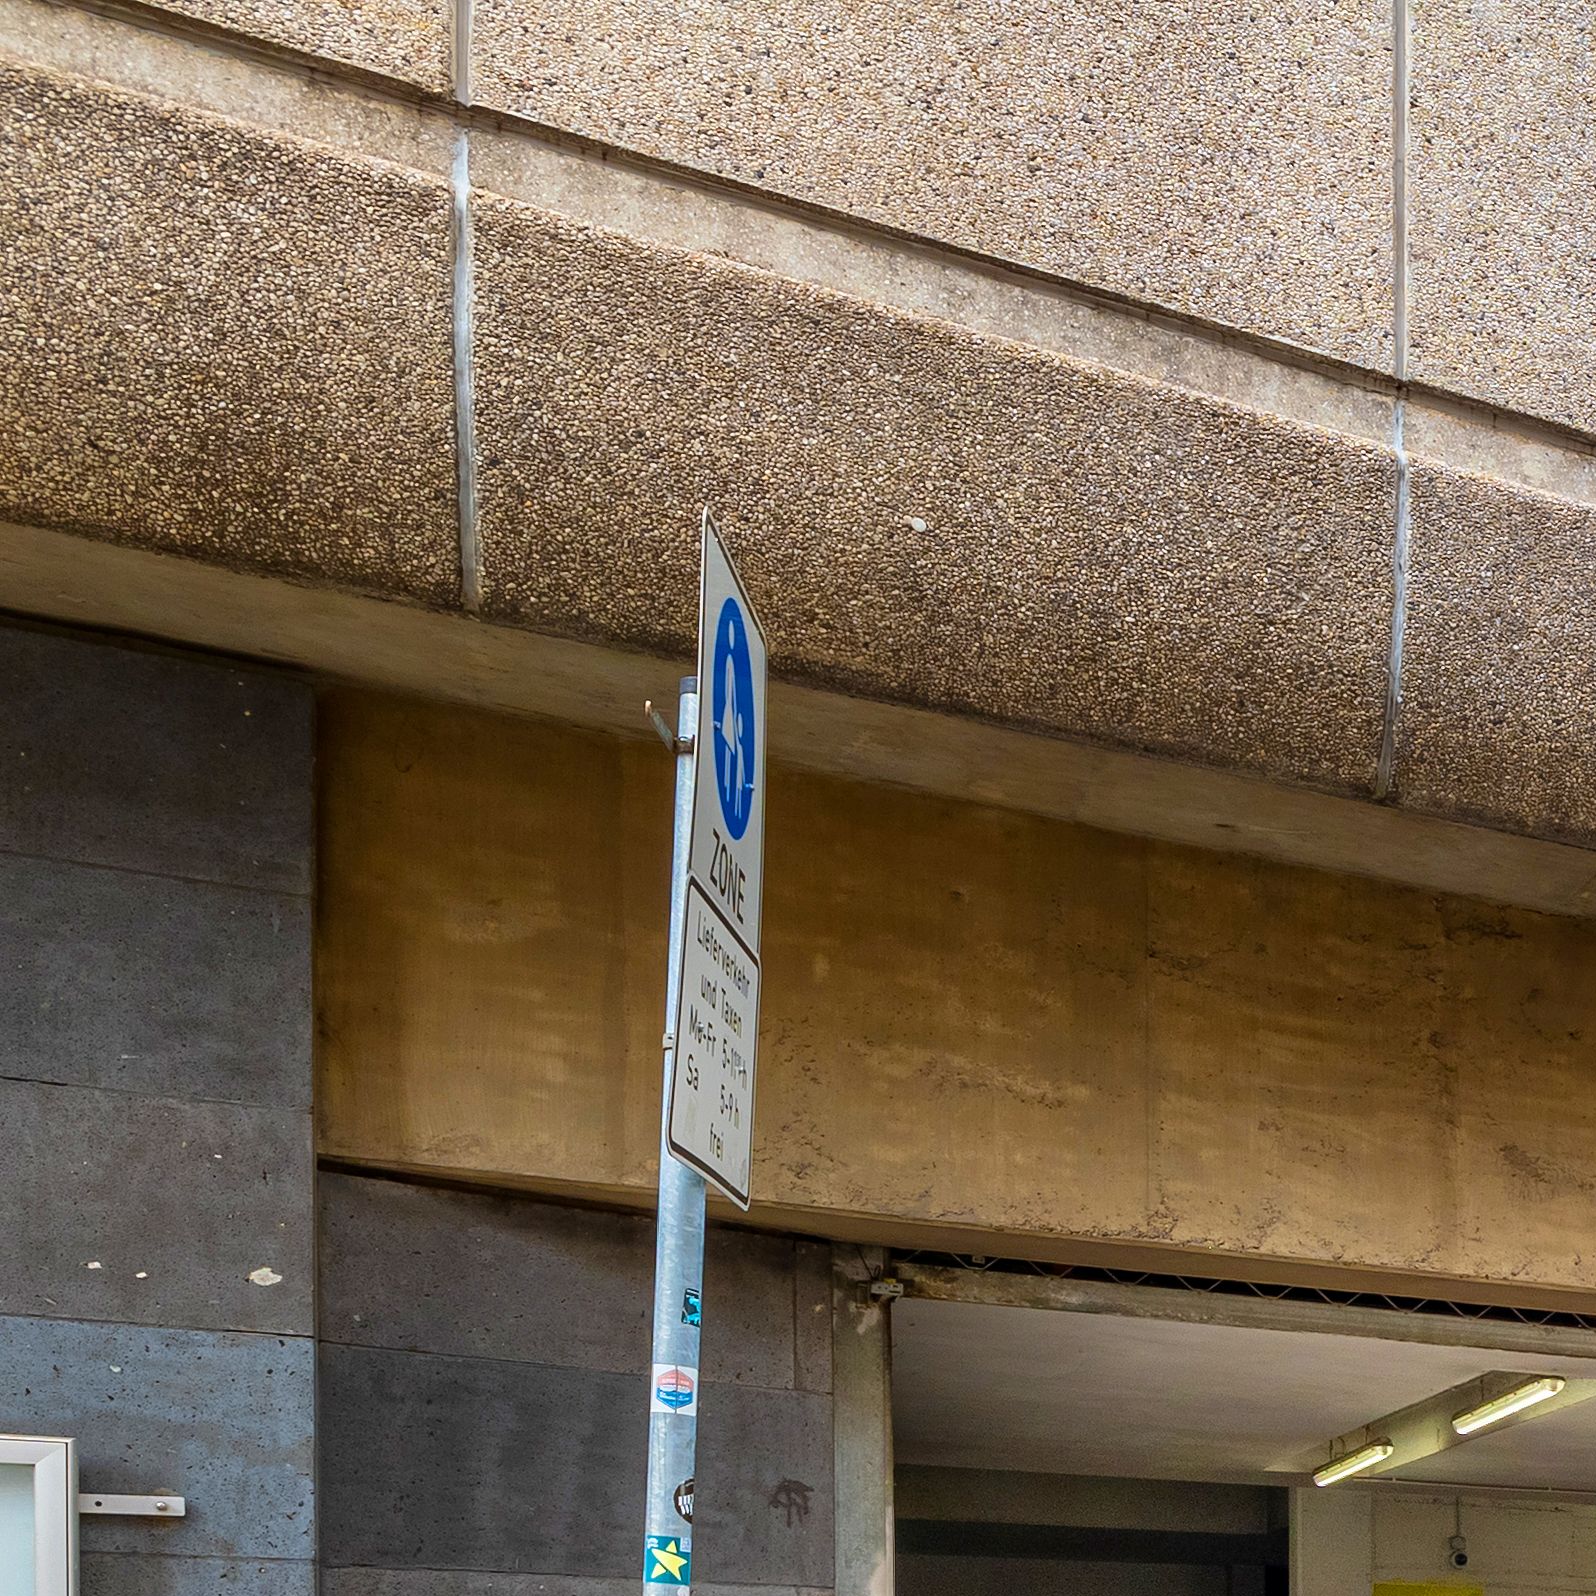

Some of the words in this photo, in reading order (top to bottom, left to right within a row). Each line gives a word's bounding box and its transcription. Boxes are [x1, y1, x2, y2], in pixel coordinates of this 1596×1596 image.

[710, 828, 746, 925] ZONE
[697, 910, 750, 999] Lieferverkehr
[701, 974, 717, 1010] und
[721, 987, 742, 1039] Taxen
[686, 1053, 698, 1092] Sa
[709, 1122, 724, 1162] frei
